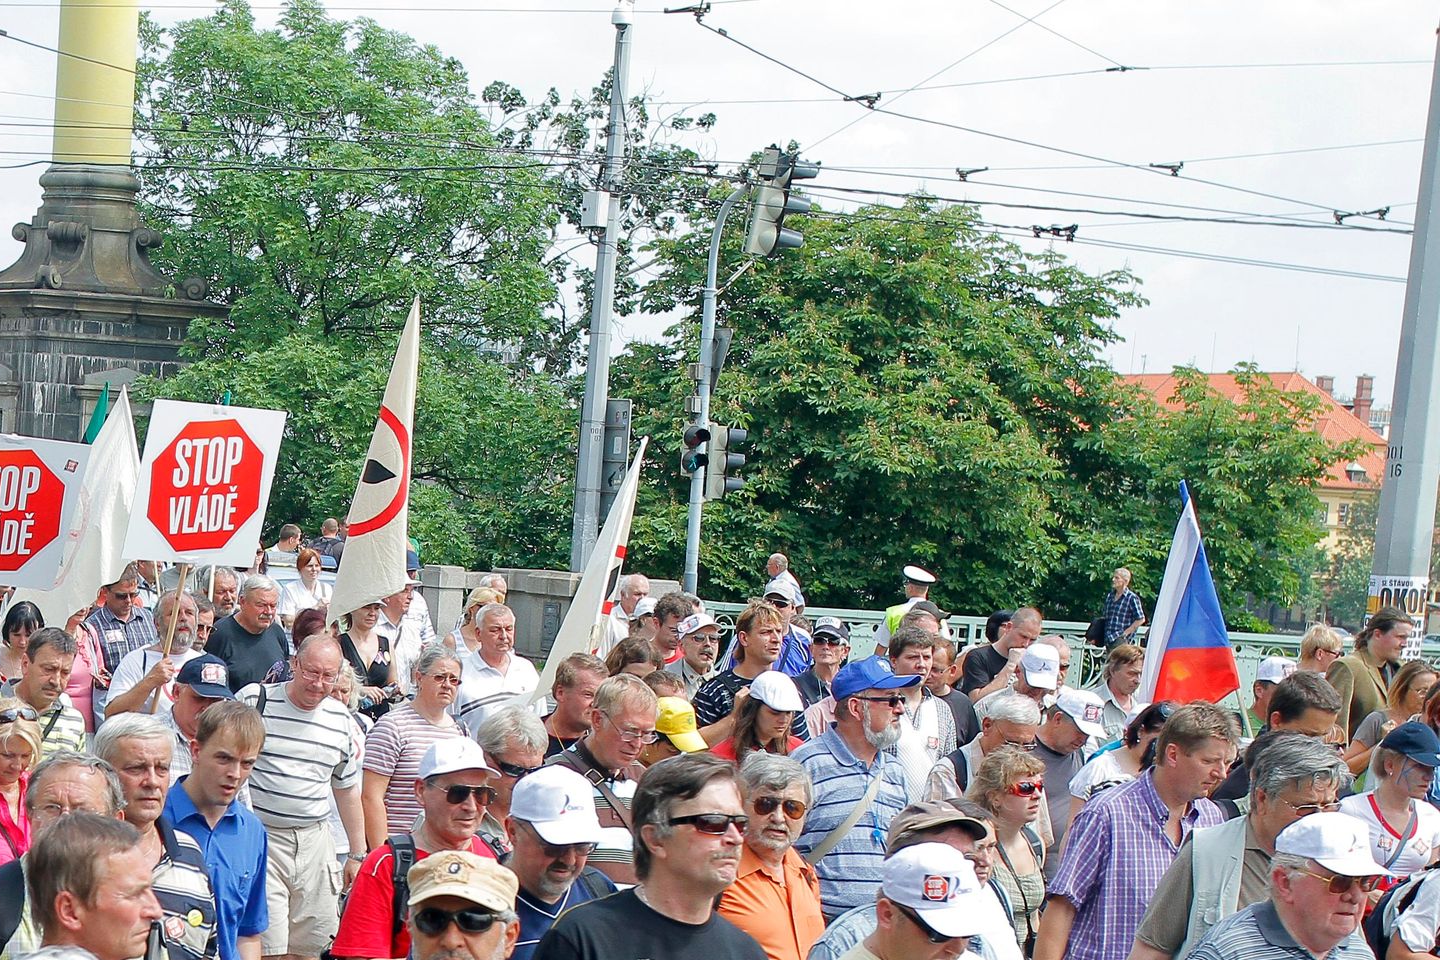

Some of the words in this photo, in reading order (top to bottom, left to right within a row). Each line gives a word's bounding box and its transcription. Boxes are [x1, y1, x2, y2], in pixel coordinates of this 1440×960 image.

[172, 436, 244, 489] STOP
[1390, 463, 1402, 478] 16
[169, 485, 239, 535] VLÁDĚ
